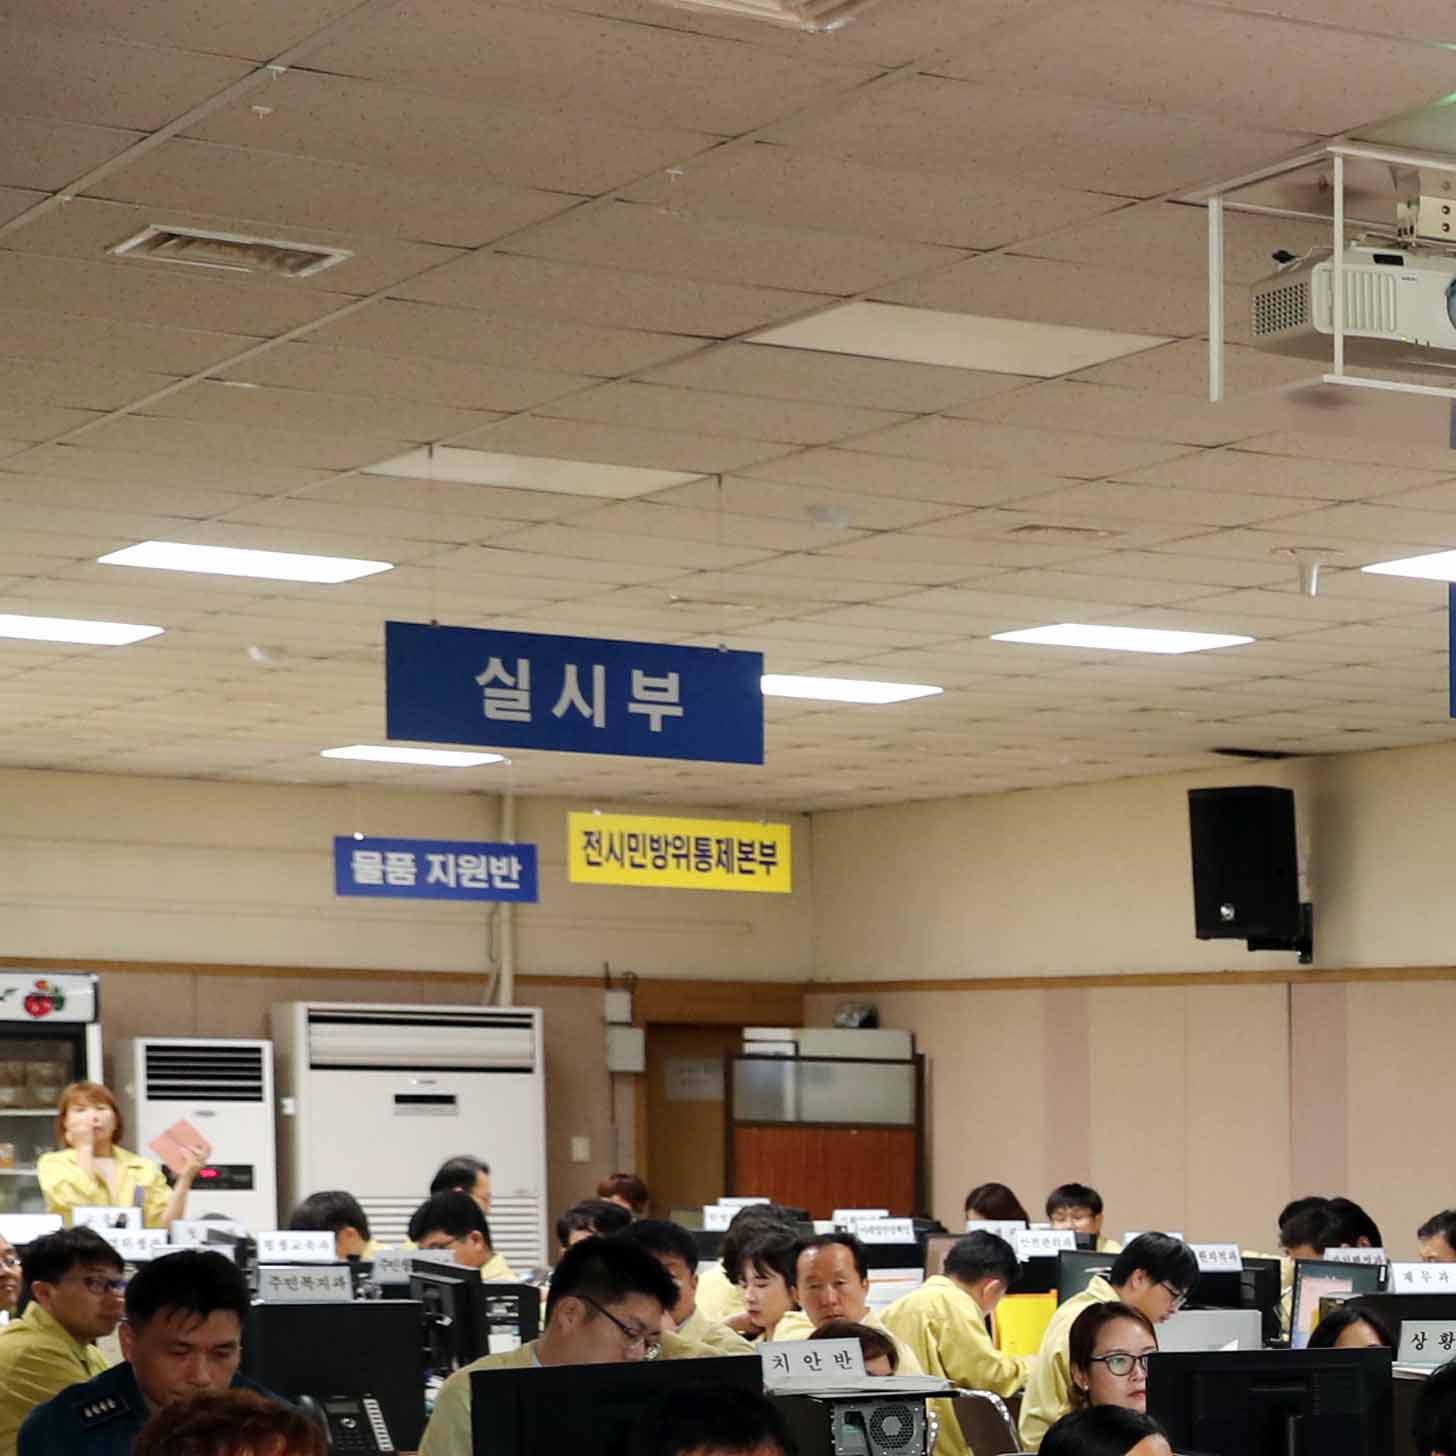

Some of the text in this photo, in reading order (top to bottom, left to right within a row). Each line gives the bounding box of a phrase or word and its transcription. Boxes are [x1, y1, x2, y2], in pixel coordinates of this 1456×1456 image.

[351, 850, 523, 890] 물품 지원반
[582, 829, 780, 877] 전시민방위통제본부
